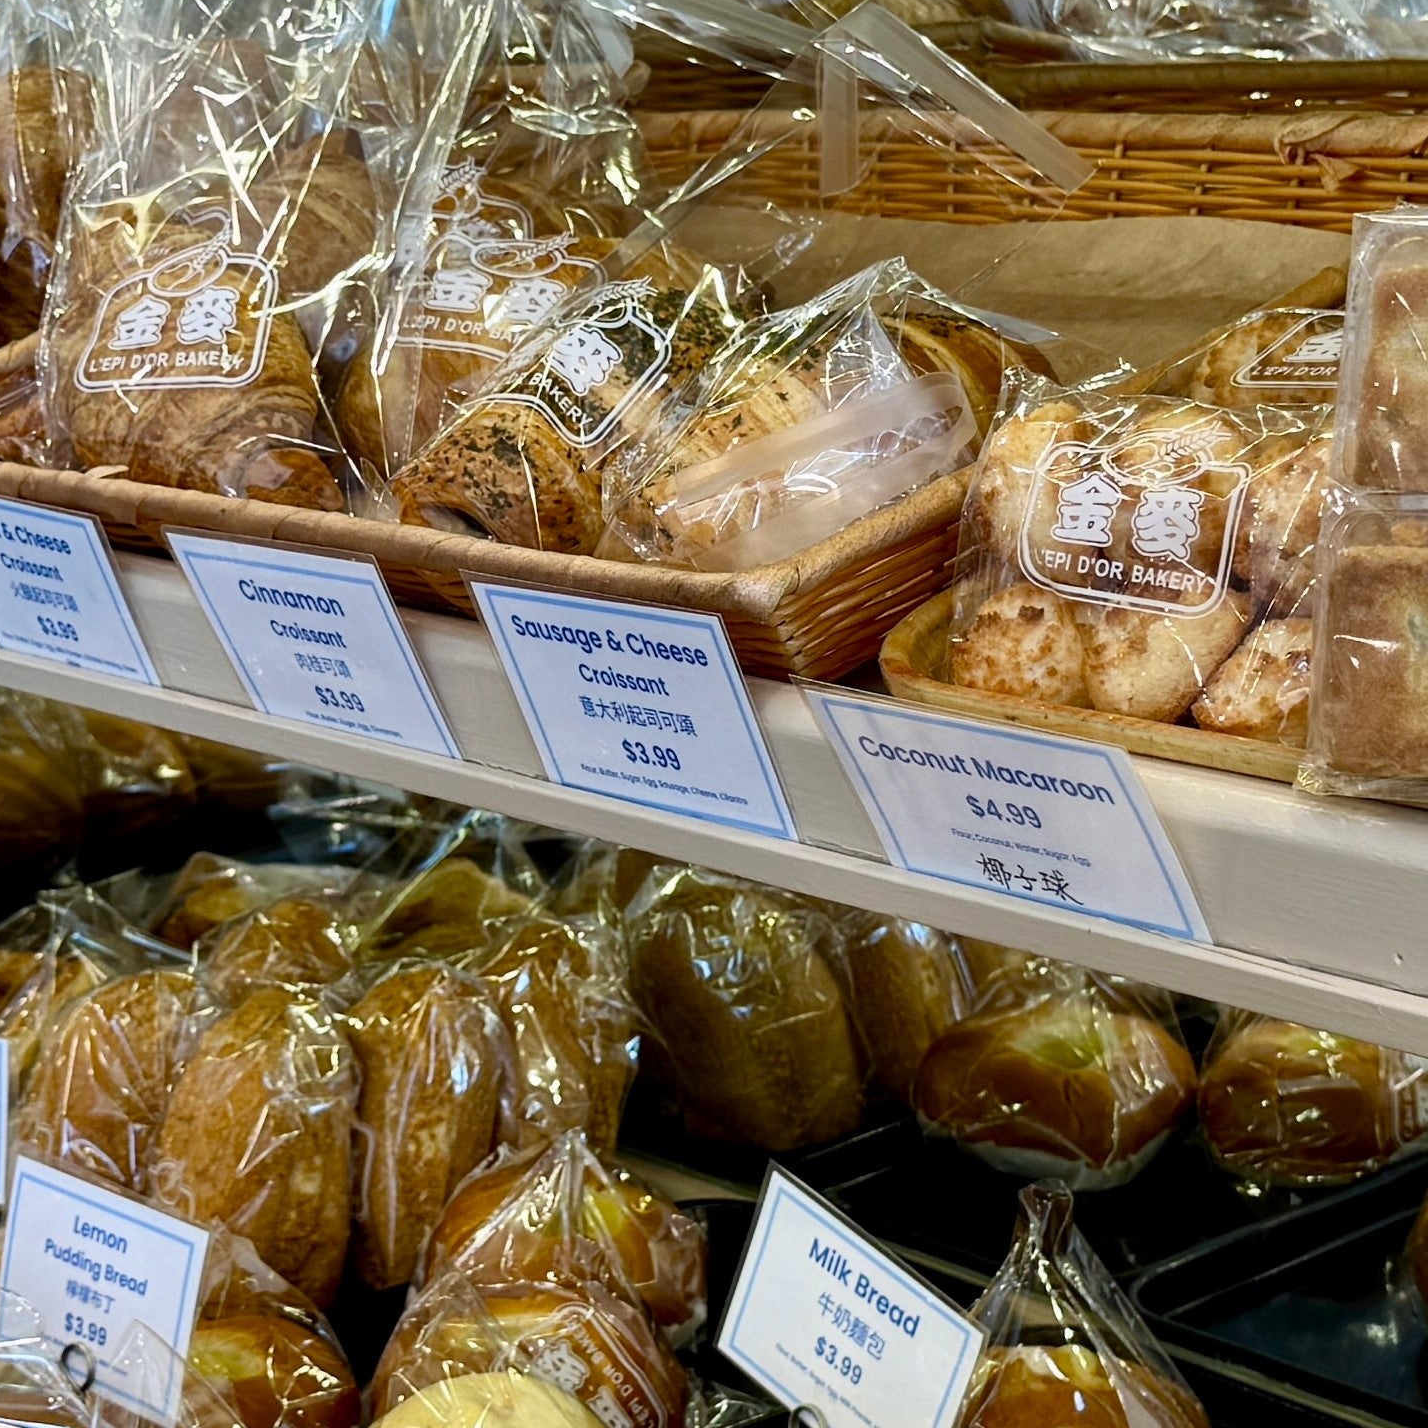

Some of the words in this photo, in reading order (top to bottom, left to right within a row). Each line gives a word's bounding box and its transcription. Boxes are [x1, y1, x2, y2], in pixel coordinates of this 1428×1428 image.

[88, 353, 129, 375] L'EPI
[129, 349, 172, 371] D'OR
[0, 521, 14, 541] &
[14, 524, 71, 556] Cheese
[0, 551, 63, 583] Croissant
[1036, 546, 1072, 573] L'EPI
[1076, 555, 1124, 582] D'OR
[1130, 564, 1211, 596] BAKERY
[238, 578, 346, 619] Cinnamon
[37, 614, 80, 643] $3.99
[270, 618, 347, 651] Croissant
[511, 613, 603, 655] Sausage
[606, 629, 625, 654] &
[625, 632, 709, 668] Cheese
[578, 662, 670, 697] Croissant
[315, 685, 365, 714] $3.99
[621, 738, 682, 772] $3.99
[858, 734, 973, 778] Coconut
[972, 756, 1116, 806] Macaroon
[966, 792, 1043, 831] $4.99
[73, 1214, 129, 1254] Lemon
[44, 1237, 102, 1282] Pudding
[104, 1265, 149, 1297] Bread
[808, 1237, 854, 1288] Milk
[854, 1272, 922, 1339] Bread
[64, 1312, 108, 1346] $3.99
[817, 1291, 887, 1361] 牛奶麵包
[813, 1335, 863, 1386] $3.99
